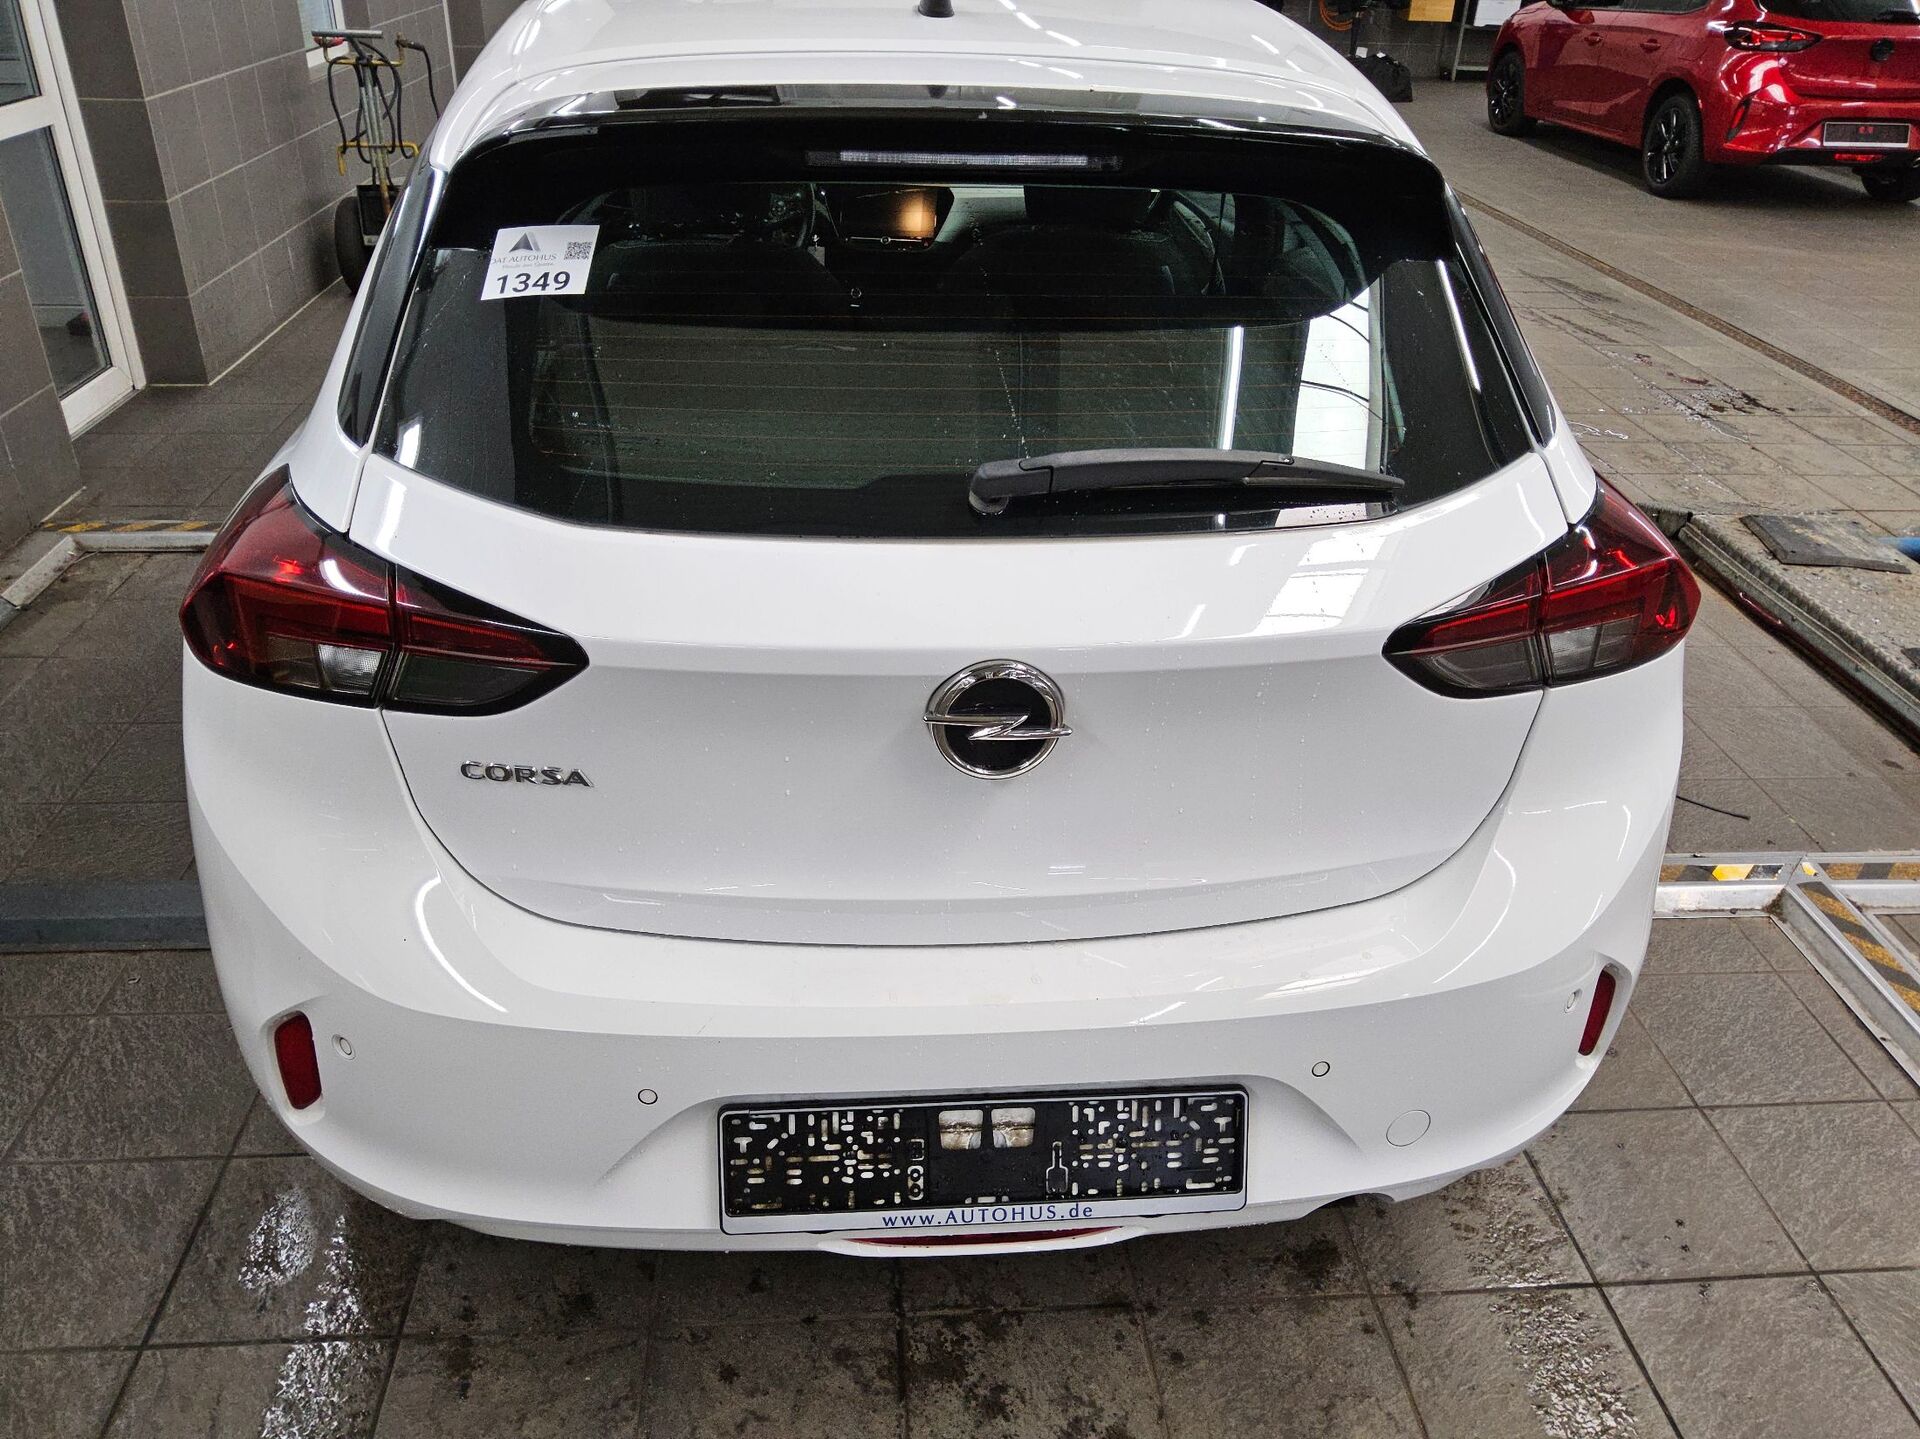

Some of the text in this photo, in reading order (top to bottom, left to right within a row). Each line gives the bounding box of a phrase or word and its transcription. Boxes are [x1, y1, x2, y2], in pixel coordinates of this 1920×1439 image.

[508, 253, 558, 263] AUTOHUS
[497, 271, 571, 294] 1349
[460, 760, 595, 787] CORSA
[882, 1203, 1093, 1227] www.AUTOHUS.de
